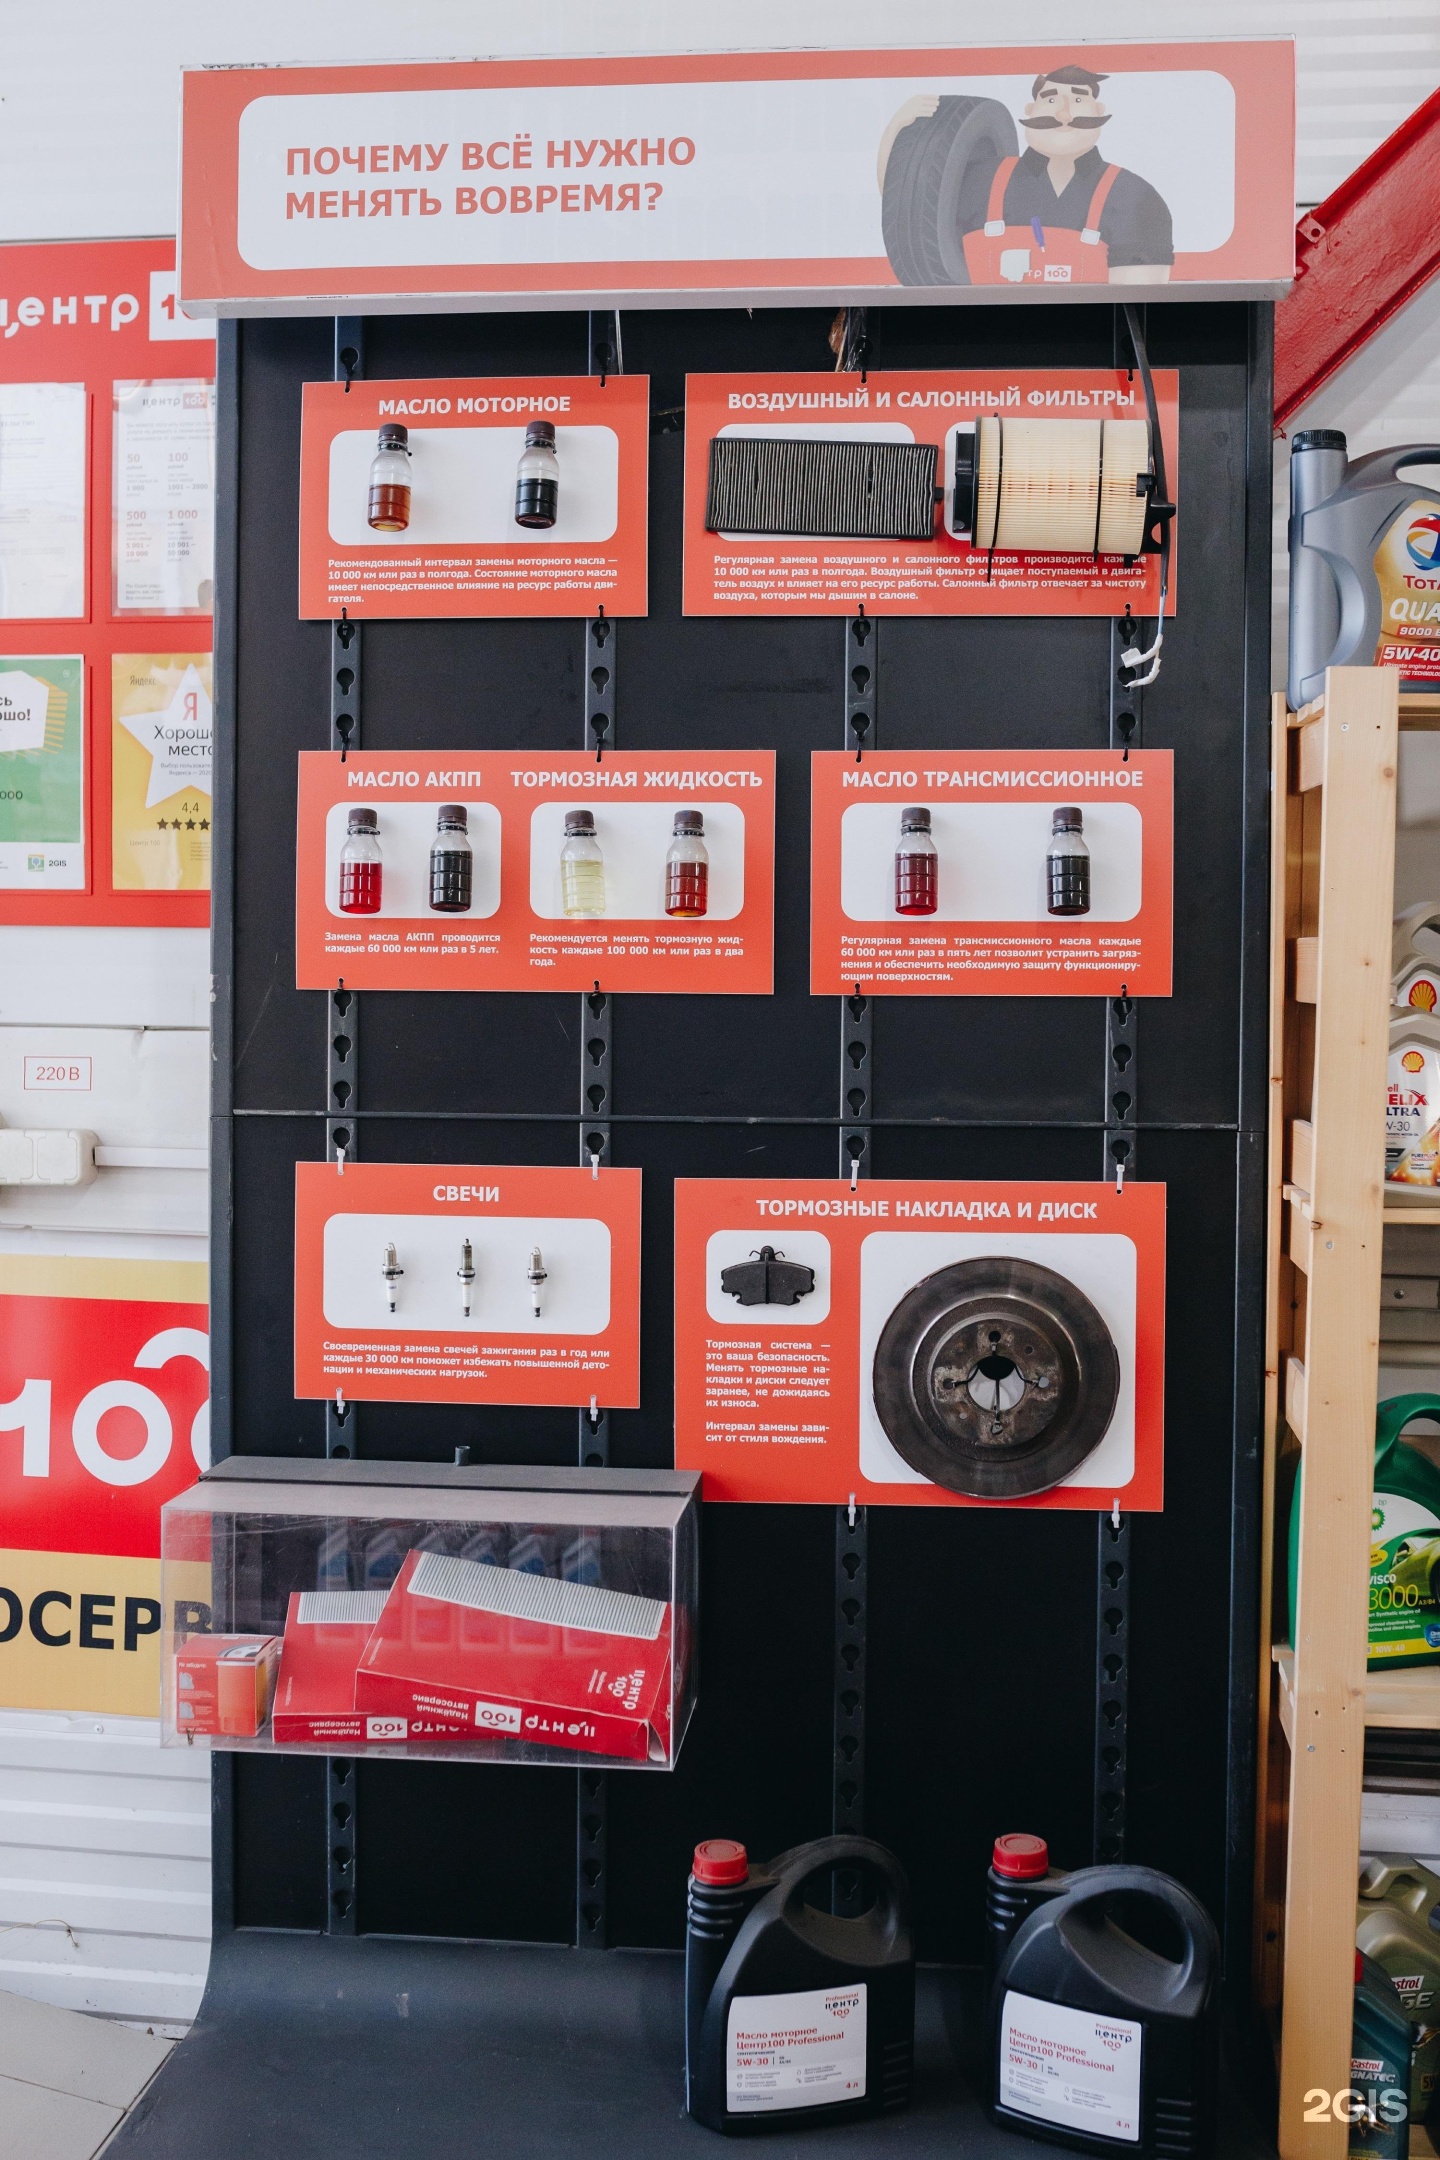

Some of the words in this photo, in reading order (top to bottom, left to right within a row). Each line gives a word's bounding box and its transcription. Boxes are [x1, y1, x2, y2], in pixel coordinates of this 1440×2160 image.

[286, 143, 450, 176] ПОЧЕМУ
[461, 138, 532, 171] ВСЁ
[546, 136, 695, 169] НУЖНО
[285, 187, 442, 219] МЕНЯТЬ
[455, 181, 663, 215] ВОВРЕМЯ?
[378, 398, 451, 415] МАСЛО
[457, 395, 570, 413] МОТОРНОЕ
[728, 391, 869, 412] ВОЗДУШНЫЙ
[875, 391, 890, 407] И
[896, 390, 1020, 408] САЛОННЫЙ
[1026, 389, 1136, 410] ФИЛЬТРЫ
[127, 453, 140, 463] 50
[168, 453, 188, 462] 100
[127, 511, 146, 520] 500
[168, 511, 174, 519] 1
[178, 510, 198, 519] 000
[328, 557, 422, 569] Рекомендованный
[424, 559, 472, 568] интервал
[475, 558, 514, 566] замены
[517, 557, 571, 567] моторного
[574, 557, 605, 565] масла
[328, 570, 340, 579] 10
[342, 570, 361, 579] 000
[363, 572, 376, 581] км
[399, 571, 417, 580] раз
[427, 570, 471, 579] полгода.
[474, 568, 528, 577] Состояние
[529, 569, 584, 578] моторного
[1403, 575, 1440, 590] TOT
[713, 592, 758, 601] воздуха,
[760, 592, 806, 601] которым
[827, 592, 867, 600] дышим
[1400, 627, 1432, 636] 9000
[1383, 646, 1440, 662] 5W-40
[130, 675, 156, 686] Яндекс
[183, 692, 198, 720] Я
[154, 725, 213, 742] Хорош
[347, 770, 419, 787] МАСЛО
[424, 771, 481, 786] АКПП
[510, 771, 637, 787] ТОРМОЗНАЯ
[643, 770, 762, 790] ЖИДКОСТЬ
[842, 770, 917, 787] МАСЛО
[922, 770, 1143, 787] ТРАНСМИССИОННОЕ
[182, 802, 199, 813] 4,4
[324, 931, 361, 941] Замена
[368, 933, 399, 941] масла
[405, 932, 434, 941] АКПП
[441, 934, 500, 943] проводится
[529, 933, 607, 944] Рекомендуется
[612, 935, 649, 943] менять
[654, 935, 712, 945] тормозную
[717, 936, 743, 944] жид-
[841, 935, 901, 946] Регулярная
[953, 937, 1052, 947] трансмиссионного
[1059, 937, 1091, 945] масла
[1098, 938, 1141, 946] каждые
[36, 1066, 65, 1080] 220
[69, 1066, 79, 1080] В
[432, 1185, 499, 1202] СВЕЧИ
[755, 1199, 889, 1216] ТОРМОЗНЫЕ
[895, 1200, 1011, 1221] НАКЛАДКА
[1017, 1201, 1031, 1217] И
[1037, 1201, 1097, 1222] ДИСК
[322, 1340, 401, 1353] Своевременная
[404, 1345, 440, 1353] замена
[443, 1344, 478, 1354] свечей
[481, 1347, 536, 1355] зажигания
[539, 1348, 557, 1358] раз
[569, 1349, 587, 1358] год
[705, 1339, 761, 1350] Тормозная
[770, 1341, 812, 1349] система
[0, 1379, 209, 1486] 10
[412, 1694, 470, 1710] автосервис
[416, 1704, 469, 1720] Надёжный
[481, 1710, 516, 1727] 100
[314, 1728, 361, 1736] Надёжный
[371, 1723, 403, 1735] 100
[525, 1715, 596, 1737] центр
[1394, 1978, 1421, 1990] strol
[825, 1992, 859, 2002] Professional
[825, 1998, 859, 2011] центр
[832, 2008, 850, 2018] 100
[736, 2031, 768, 2039] Масло
[770, 2027, 817, 2039] моторное
[1095, 2022, 1132, 2034] Professional
[736, 2039, 785, 2050] Центр100
[788, 2031, 844, 2047] Professional
[1009, 2027, 1038, 2043] Масло
[1040, 2038, 1086, 2056] моторное
[1095, 2029, 1132, 2044] центр
[1103, 2040, 1121, 2050] 100
[1009, 2036, 1053, 2057] Центр100
[1056, 2051, 1115, 2072] Professional
[736, 2057, 769, 2066] 5W-30
[1009, 2054, 1038, 2070] 5W-30
[1124, 2121, 1130, 2129] л
